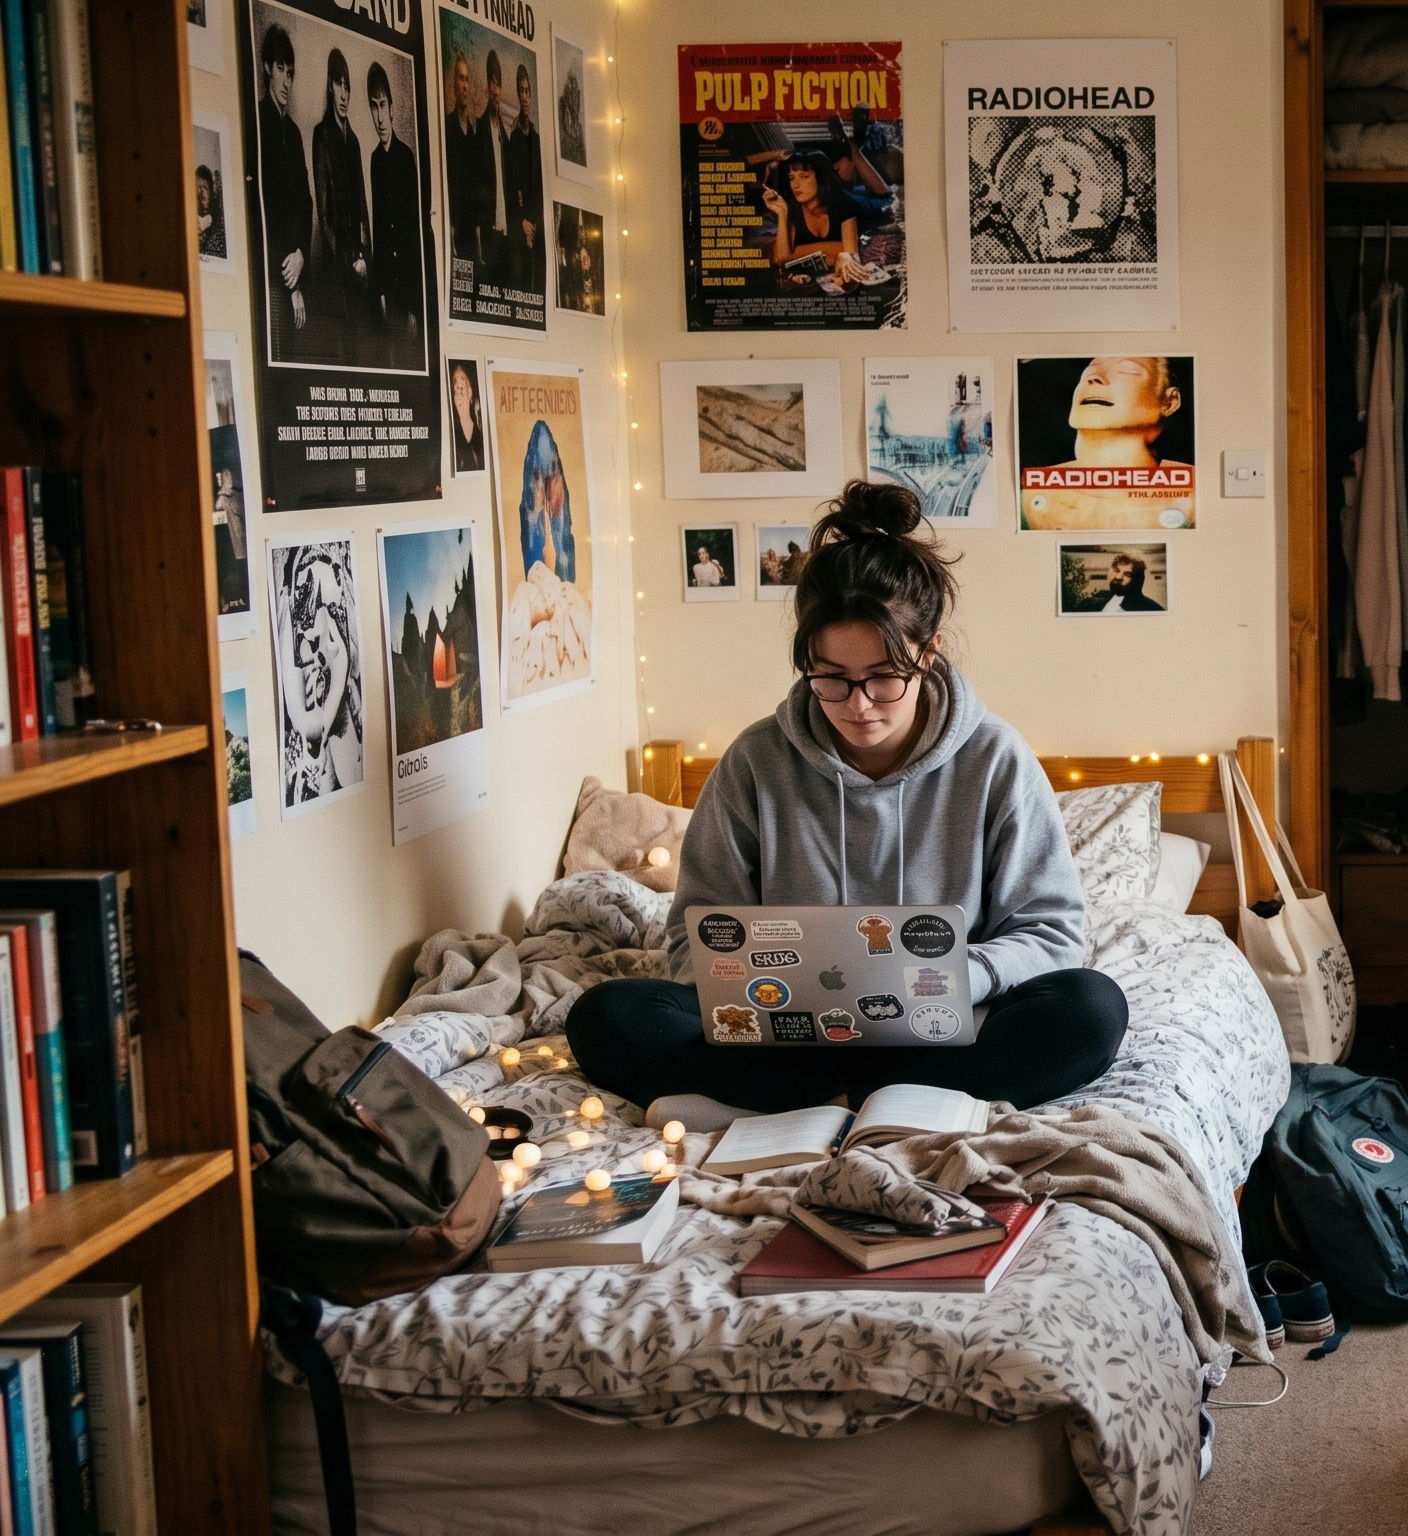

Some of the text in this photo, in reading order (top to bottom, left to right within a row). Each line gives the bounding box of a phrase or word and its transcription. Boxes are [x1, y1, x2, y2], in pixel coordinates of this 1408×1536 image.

[694, 69, 888, 112] PULP FICTION
[967, 86, 1155, 110] RADIOHEAD
[1026, 469, 1191, 487] RADIOHEAD
